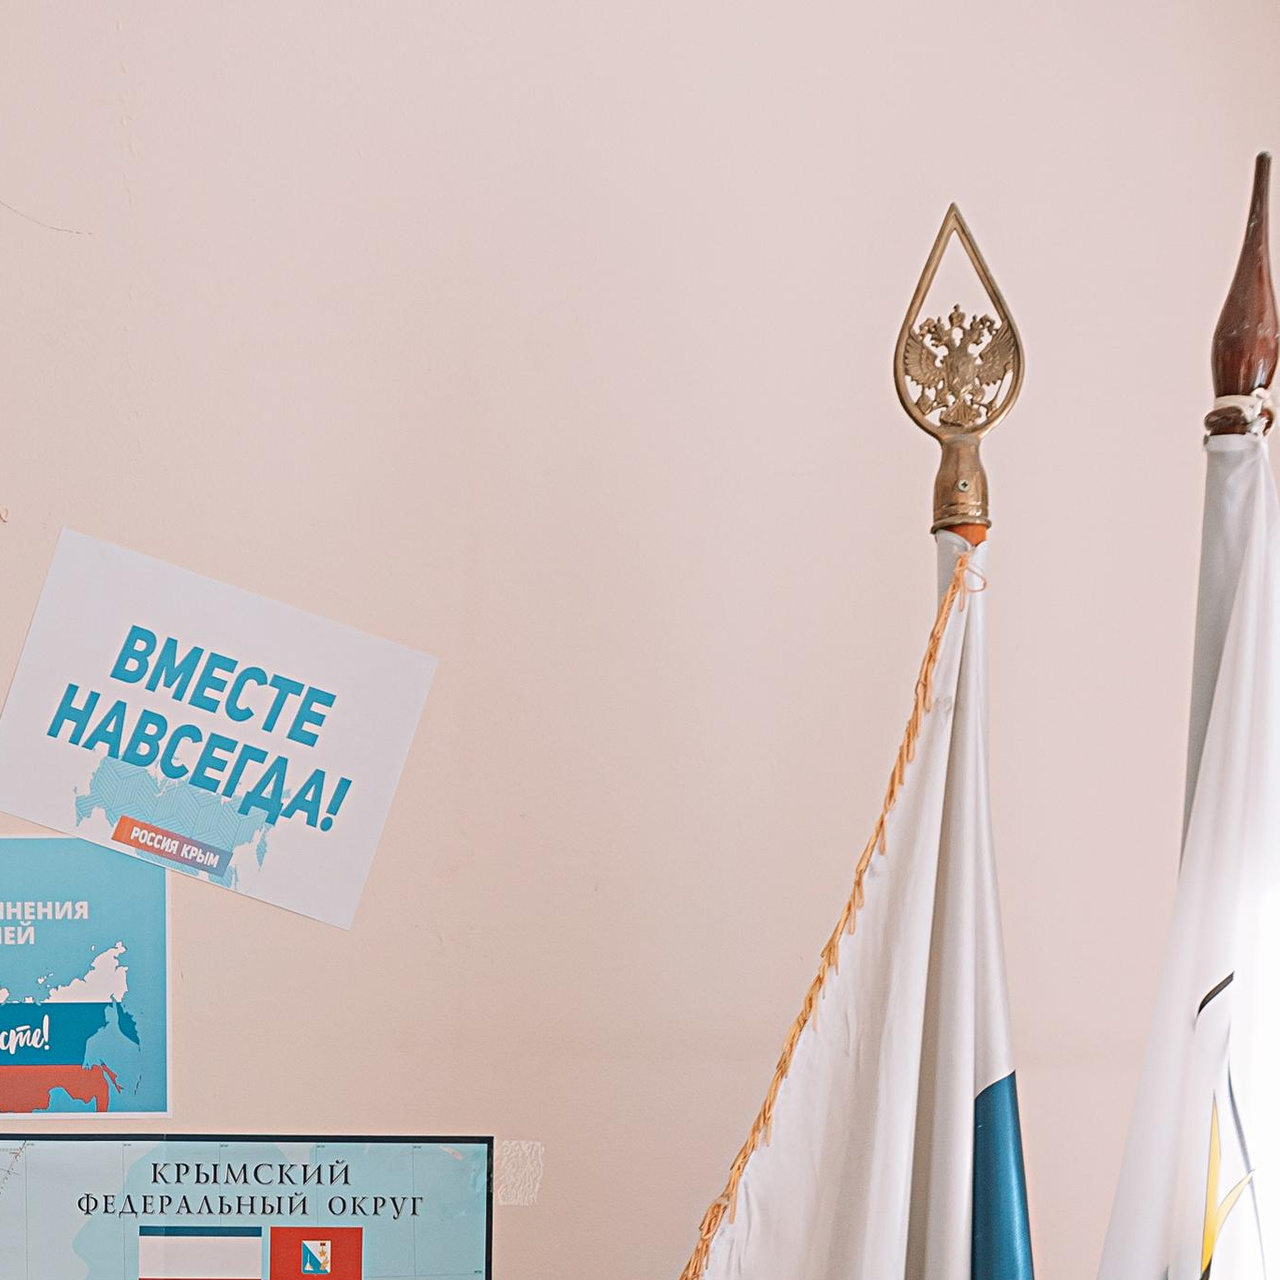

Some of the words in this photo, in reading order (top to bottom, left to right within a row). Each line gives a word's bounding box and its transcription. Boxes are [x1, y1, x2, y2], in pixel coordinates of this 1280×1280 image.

[110, 624, 337, 747] ВМЕСТЕ
[46, 683, 352, 832] НАВСЕГДА!
[130, 826, 179, 855] РОССИЯ
[180, 843, 220, 868] КРЫМ
[150, 1159, 351, 1185] КРЫМСКИЙ
[77, 1192, 310, 1219] ФЕДЕРАЛЬНЫЙ
[328, 1195, 424, 1221] ОКРУГ
